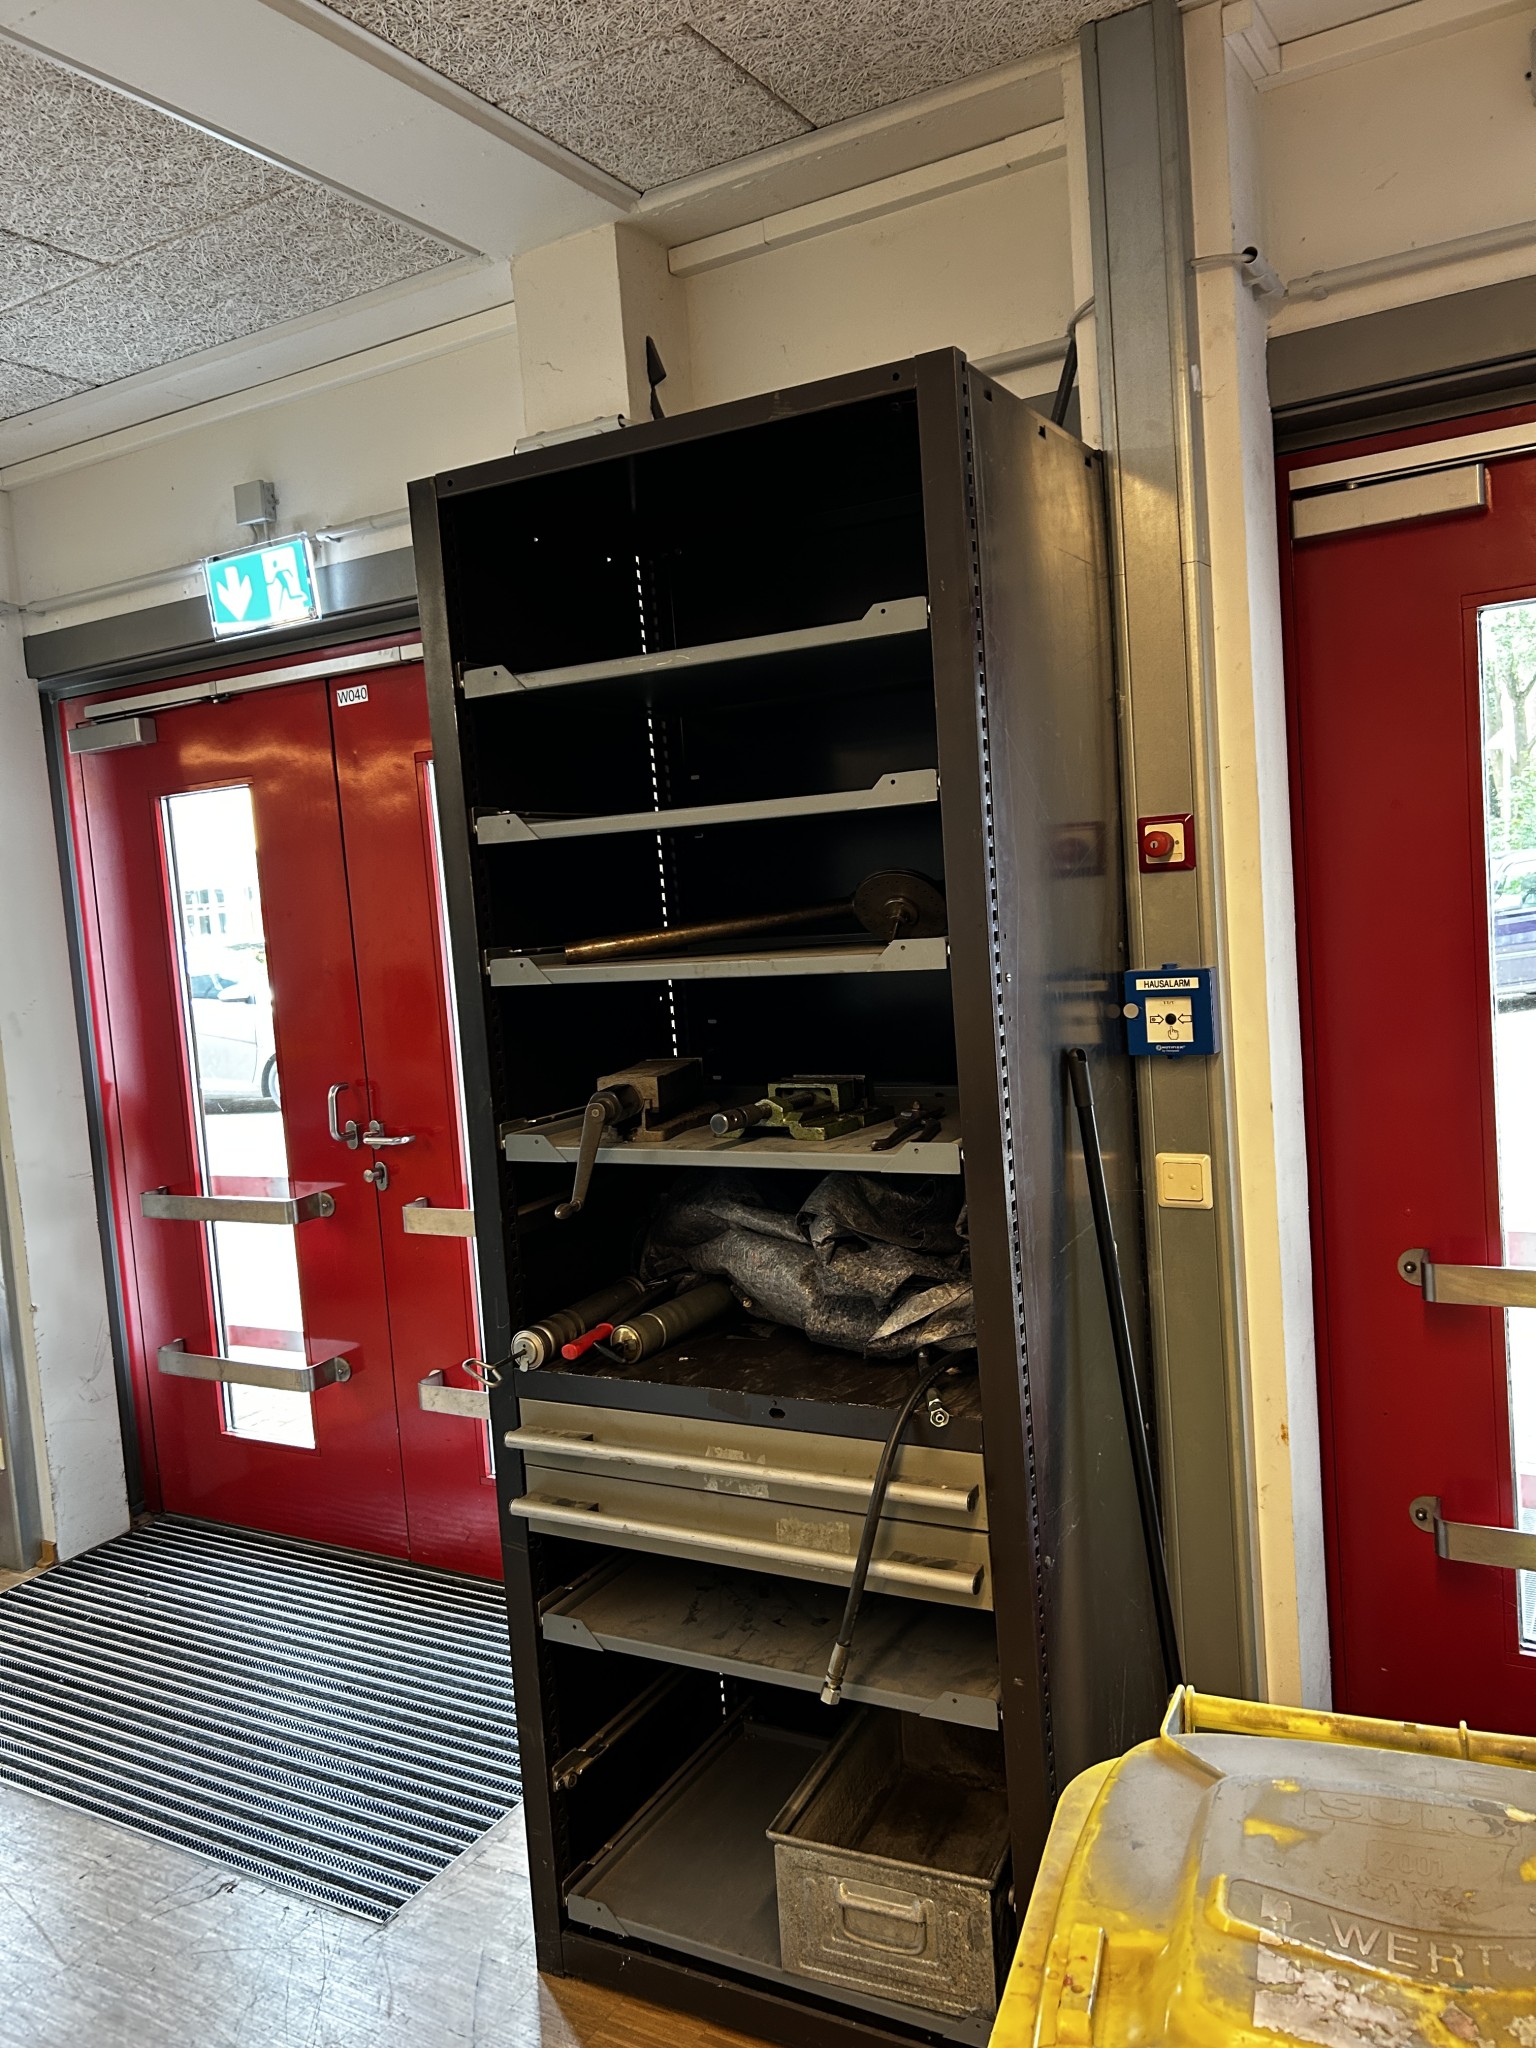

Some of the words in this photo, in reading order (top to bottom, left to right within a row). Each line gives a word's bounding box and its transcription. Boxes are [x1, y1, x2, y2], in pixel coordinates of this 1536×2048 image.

[338, 687, 367, 704] W040
[1144, 979, 1191, 989] HAUSALARM
[1380, 1850, 1445, 1880] 2001
